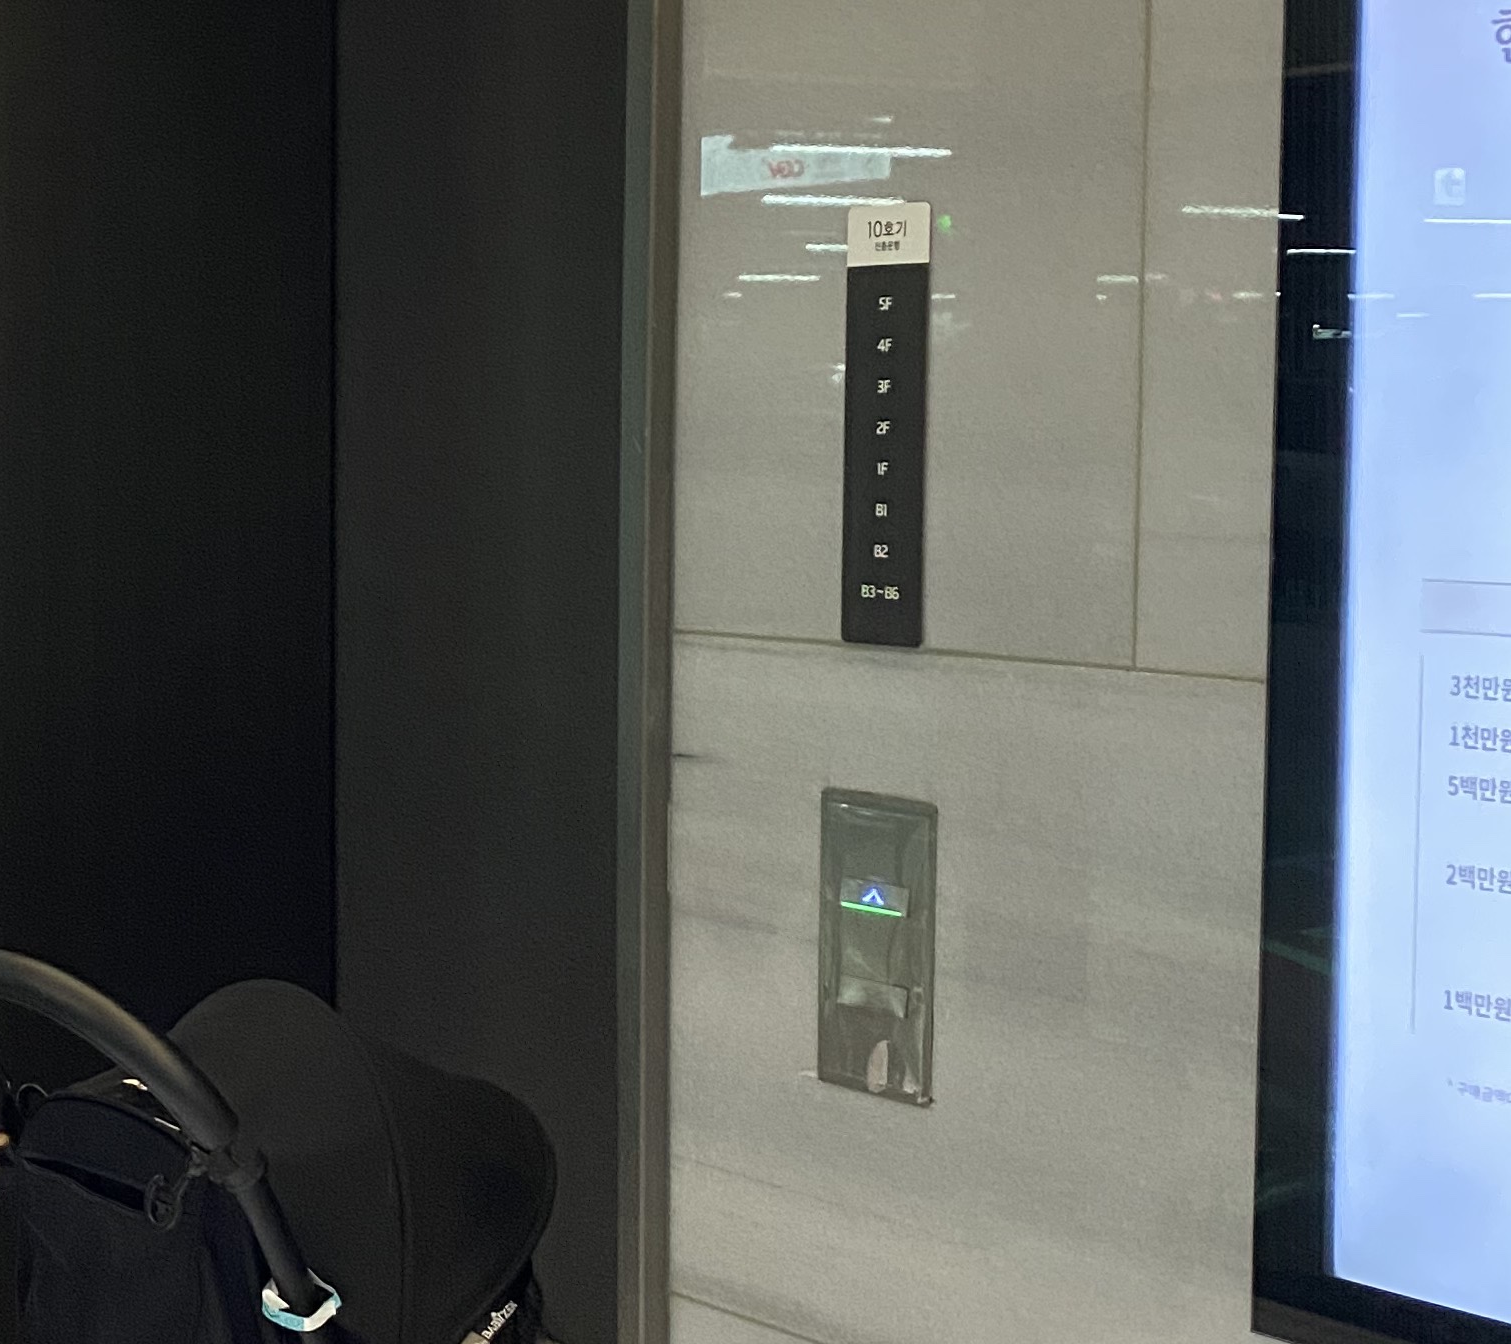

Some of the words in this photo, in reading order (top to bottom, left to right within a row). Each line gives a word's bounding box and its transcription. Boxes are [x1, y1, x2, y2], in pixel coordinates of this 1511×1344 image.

[868, 220, 907, 239] 10호기
[879, 297, 892, 310] 5F
[877, 338, 892, 352] 4F
[877, 380, 891, 394] 3F
[876, 421, 890, 435] 2F
[877, 462, 889, 476] 1F
[875, 504, 887, 517] B1
[874, 545, 889, 558] B2
[861, 585, 900, 601] B3~B6
